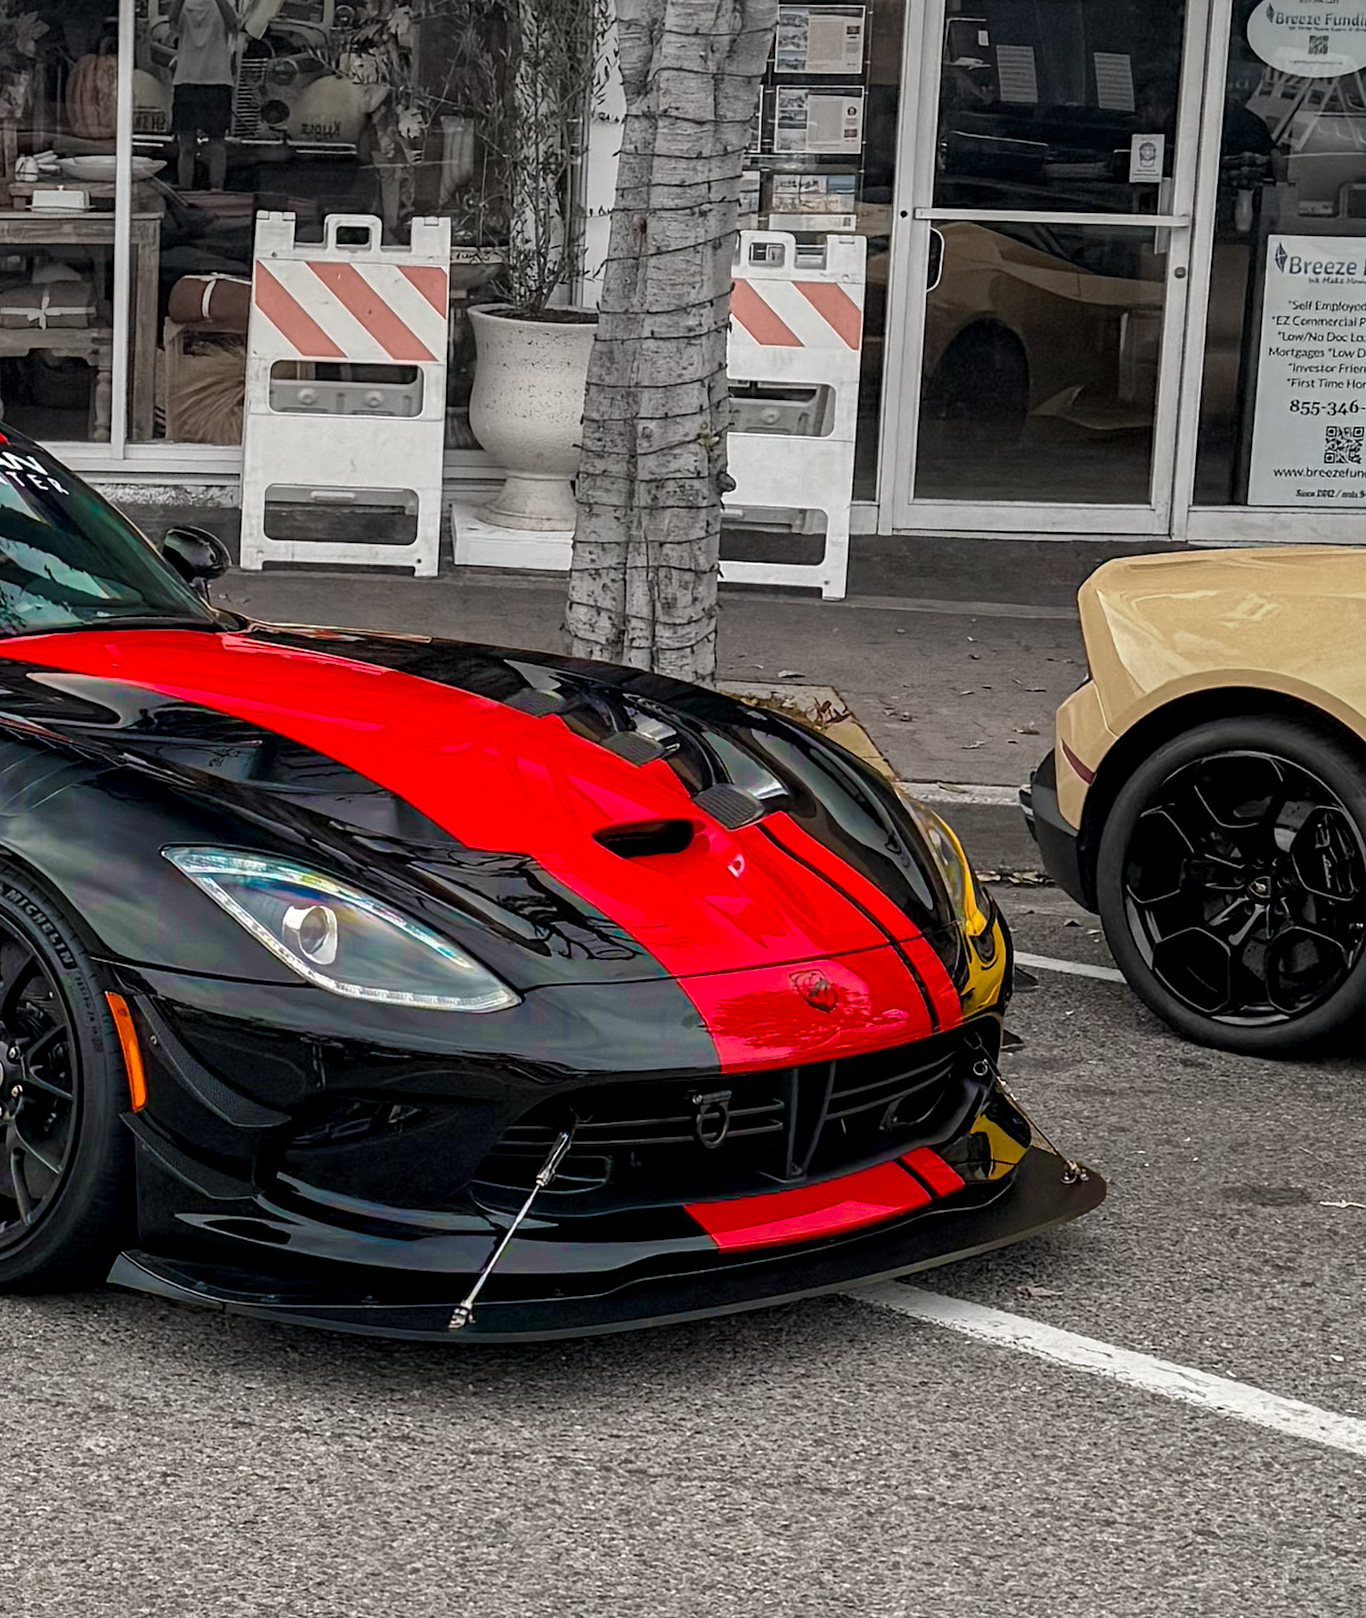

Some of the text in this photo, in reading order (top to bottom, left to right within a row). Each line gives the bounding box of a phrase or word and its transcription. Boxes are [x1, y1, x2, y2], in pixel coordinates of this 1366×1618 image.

[1325, 12, 1366, 26] Fundi
[1289, 256, 1357, 275] Breeze
[1292, 315, 1357, 327] Commercial
[1326, 331, 1348, 342] Doc
[1268, 346, 1326, 359] Mortgages
[1318, 377, 1344, 389] Time
[1273, 466, 1366, 478] www.breezefun
[3, 887, 76, 969] MICHELIN
